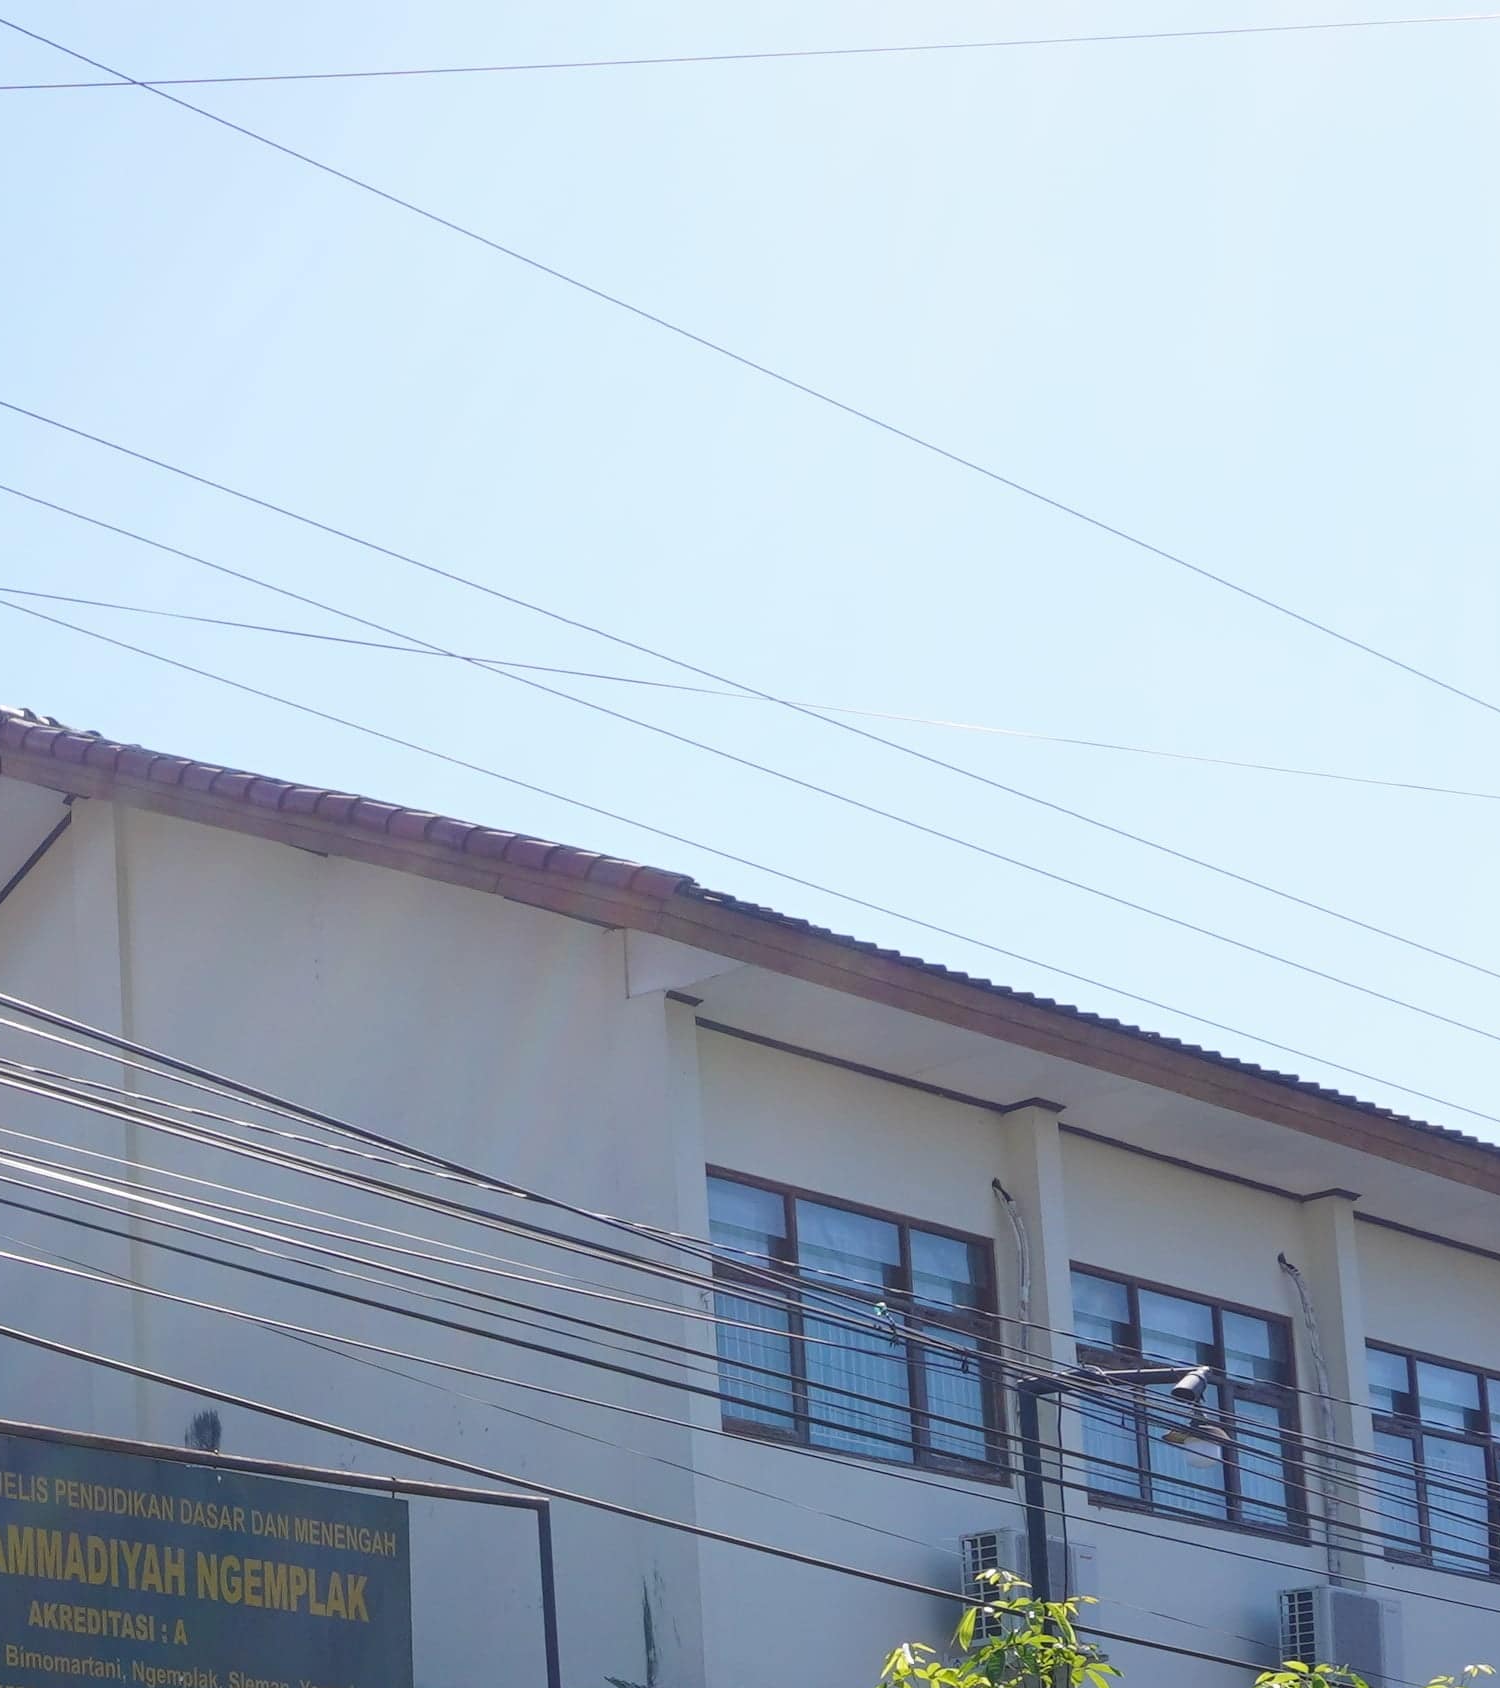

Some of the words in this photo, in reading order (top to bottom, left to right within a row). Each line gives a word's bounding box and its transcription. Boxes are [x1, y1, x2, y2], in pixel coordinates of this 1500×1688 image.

[56, 1479, 174, 1521] PENDIDIKAN
[181, 1500, 246, 1533] DASAR
[252, 1510, 289, 1540] DAN
[294, 1518, 396, 1556] MENENGAH
[197, 1551, 369, 1623] NGEMPLAK
[28, 1600, 154, 1642] AKREDITASI
[174, 1619, 188, 1645] A
[6, 1645, 126, 1681] Bimomartani,
